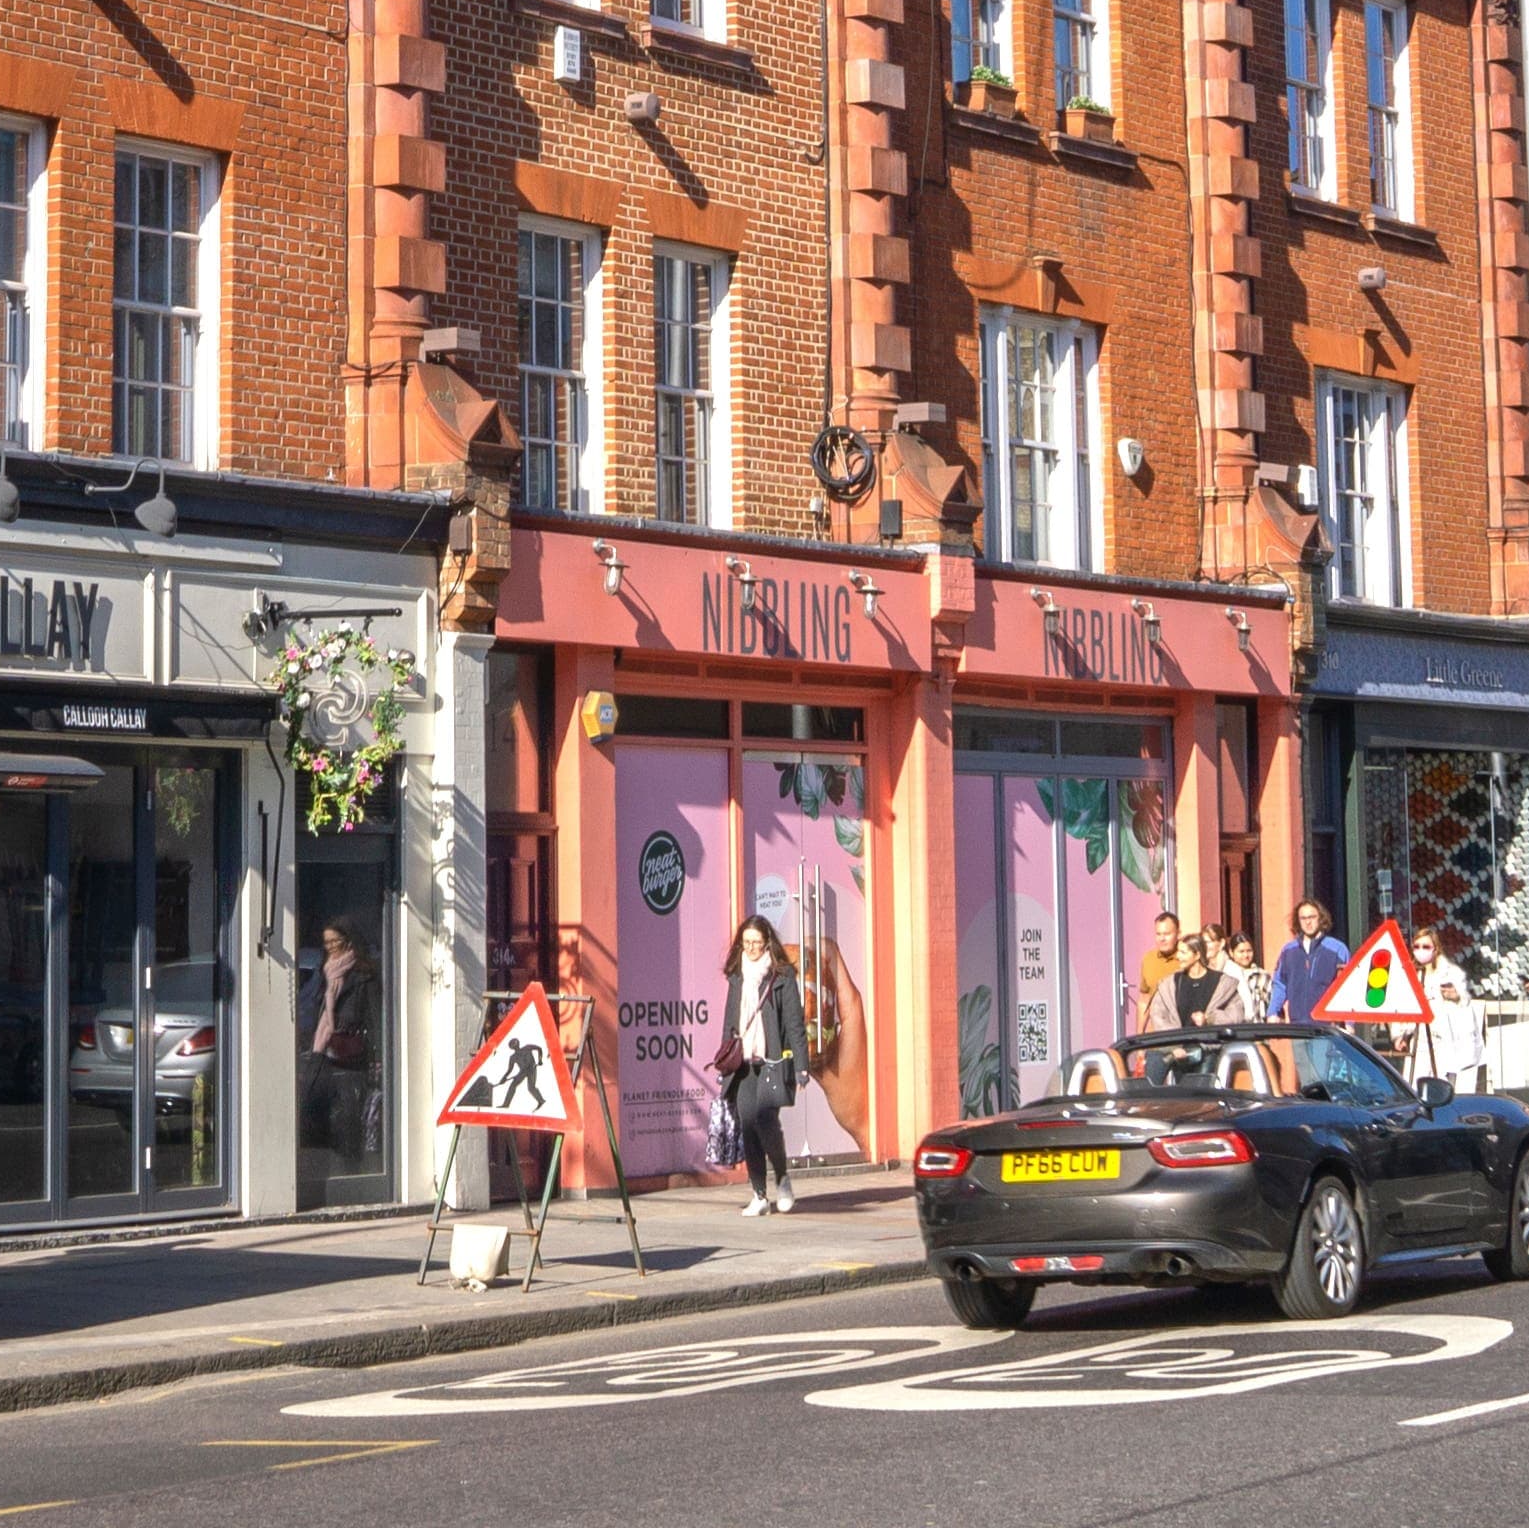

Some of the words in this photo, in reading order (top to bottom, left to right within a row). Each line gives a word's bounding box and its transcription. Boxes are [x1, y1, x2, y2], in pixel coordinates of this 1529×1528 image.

[702, 571, 852, 663] NIBBLING
[1321, 651, 1339, 670] 310
[1425, 656, 1458, 685] Little
[1460, 658, 1504, 689] Greene
[63, 704, 109, 729] CALLOOH
[110, 707, 147, 729] CALLAY
[1020, 928, 1042, 943] JOIN
[1022, 947, 1041, 961] THE
[1019, 965, 1045, 980] TEAM
[618, 999, 709, 1029] OPENING
[635, 1033, 693, 1061] SOON
[623, 1091, 650, 1102] PLANET
[651, 1089, 685, 1101] FRIENDLY
[686, 1087, 706, 1099] FOOD
[1012, 1152, 1063, 1176] PF66
